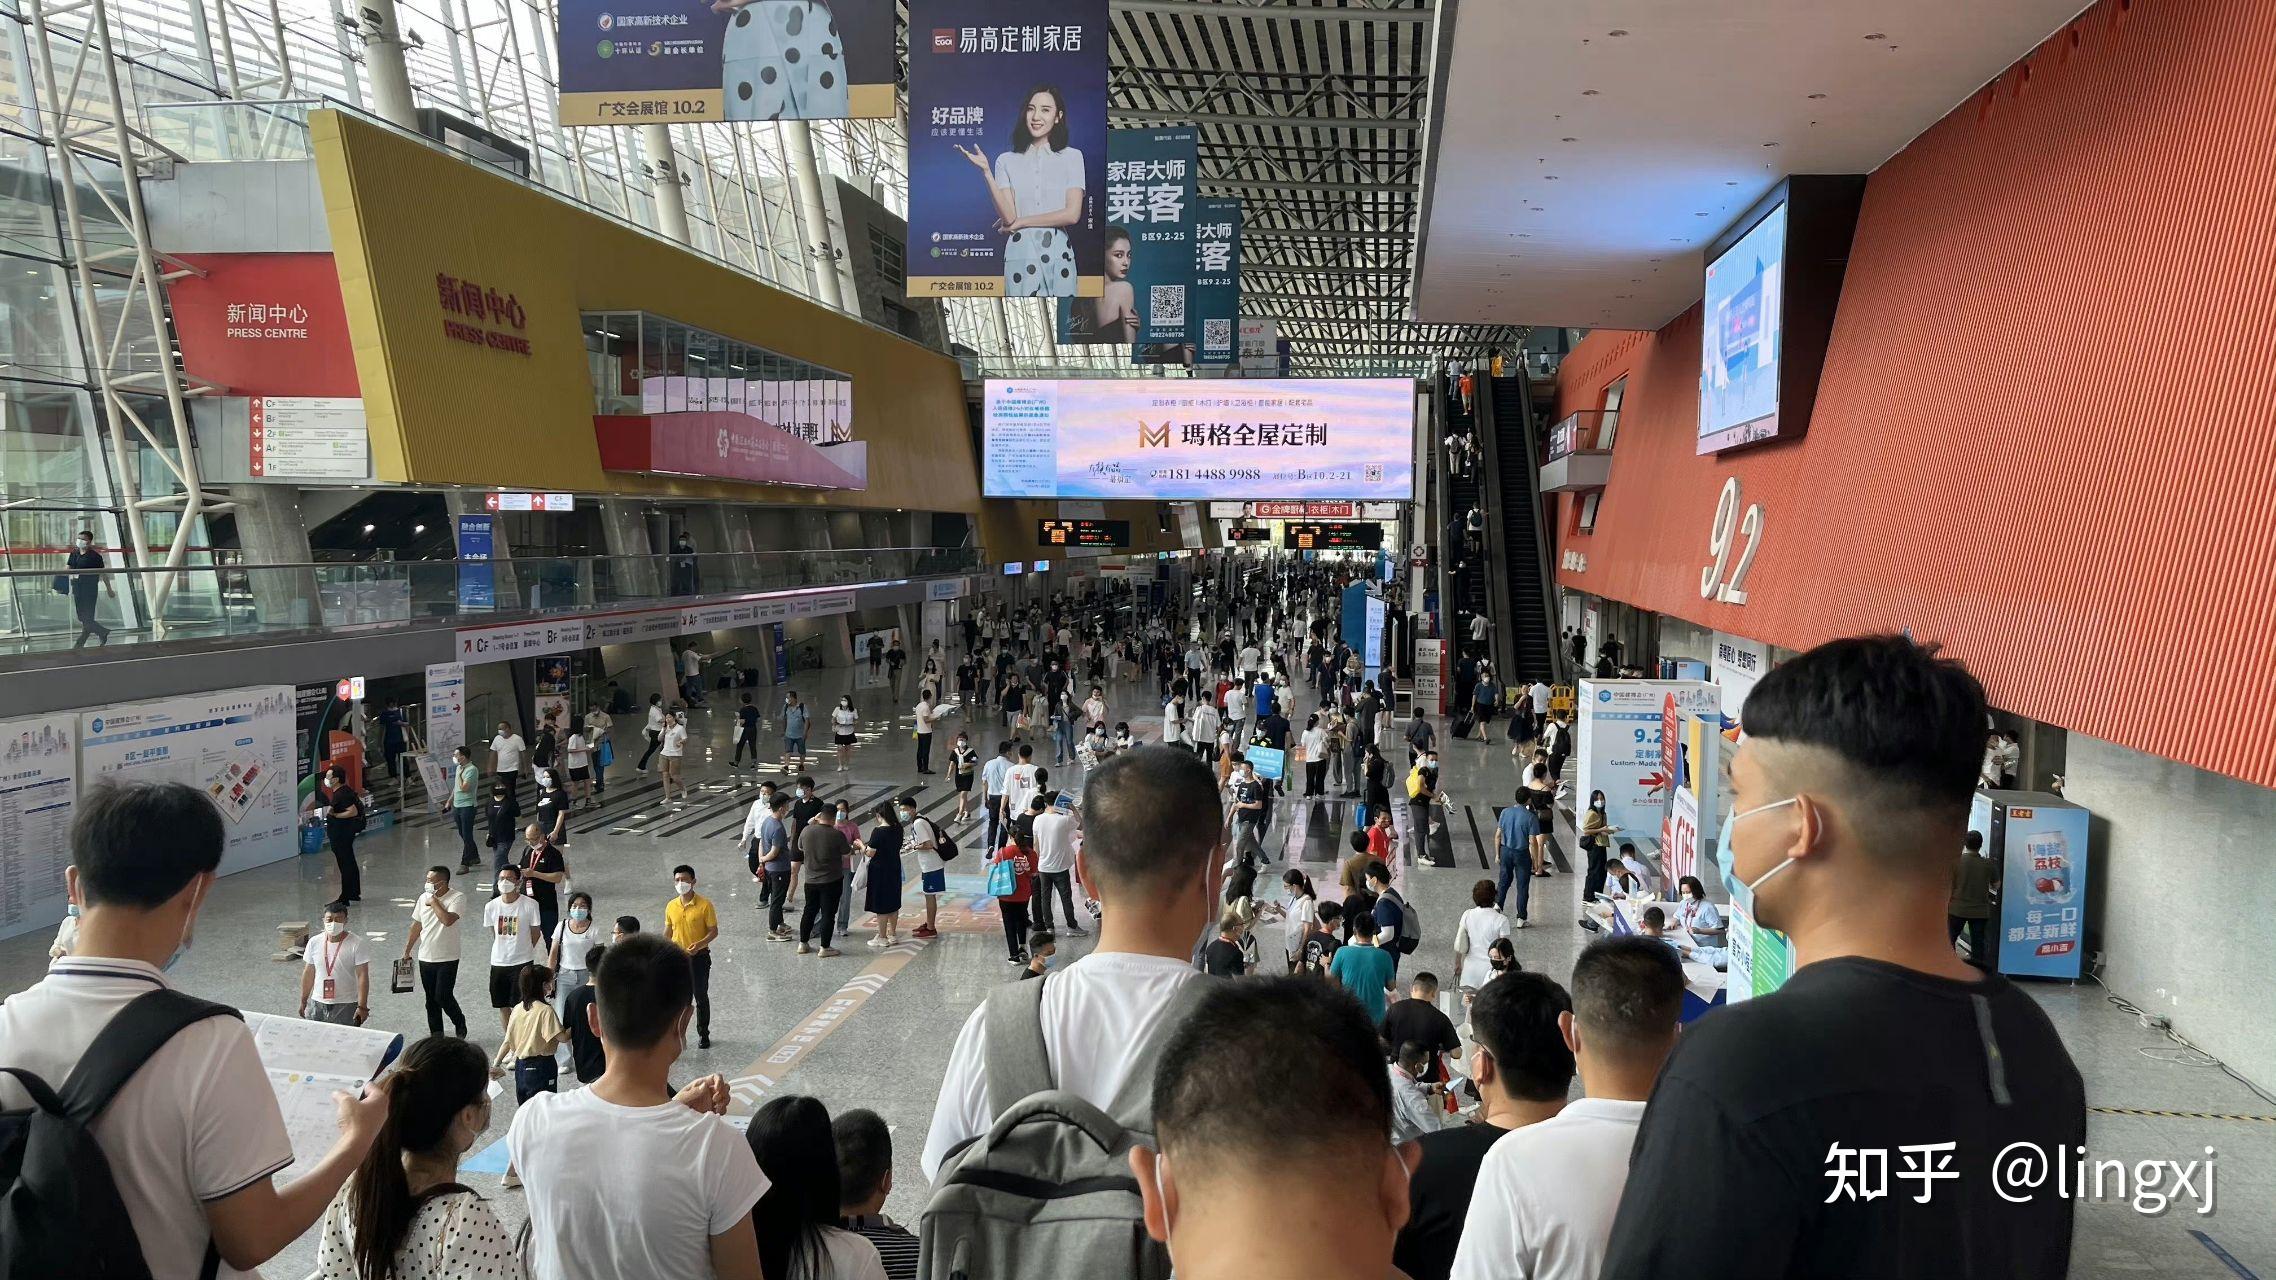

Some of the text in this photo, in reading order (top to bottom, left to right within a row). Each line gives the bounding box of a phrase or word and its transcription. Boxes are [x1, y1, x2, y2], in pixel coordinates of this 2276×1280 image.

[616, 14, 688, 27] 国家高新技术企业
[959, 25, 1082, 54] 易高定制家居
[598, 100, 706, 116] 广交会展馆 10.2
[931, 106, 984, 125] 好品牌
[931, 128, 984, 137] 应该更懂生活
[1107, 159, 1186, 182] 家居大师
[1107, 183, 1185, 224] 莱客
[1142, 232, 1185, 241] B区9.2-25
[930, 281, 994, 291] 广交会展馆 10.2
[436, 272, 527, 331] 新闻中心
[227, 303, 309, 325] 新闻中心
[227, 328, 308, 339] PRESS CENTRE
[443, 319, 532, 357] PRESS CENTRE
[1181, 422, 1328, 447] 瑪格全屋定制
[1169, 468, 1190, 480] 181
[1195, 468, 1226, 480] 4488
[1229, 468, 1261, 480] 9988
[1331, 505, 1350, 515] 木门
[477, 638, 489, 652] CF
[1610, 759, 1657, 767] Custom-Made
[2034, 856, 2062, 870] 荔枝
[2025, 907, 2077, 924] 每一口
[2008, 922, 2078, 942] 都是新鲜
